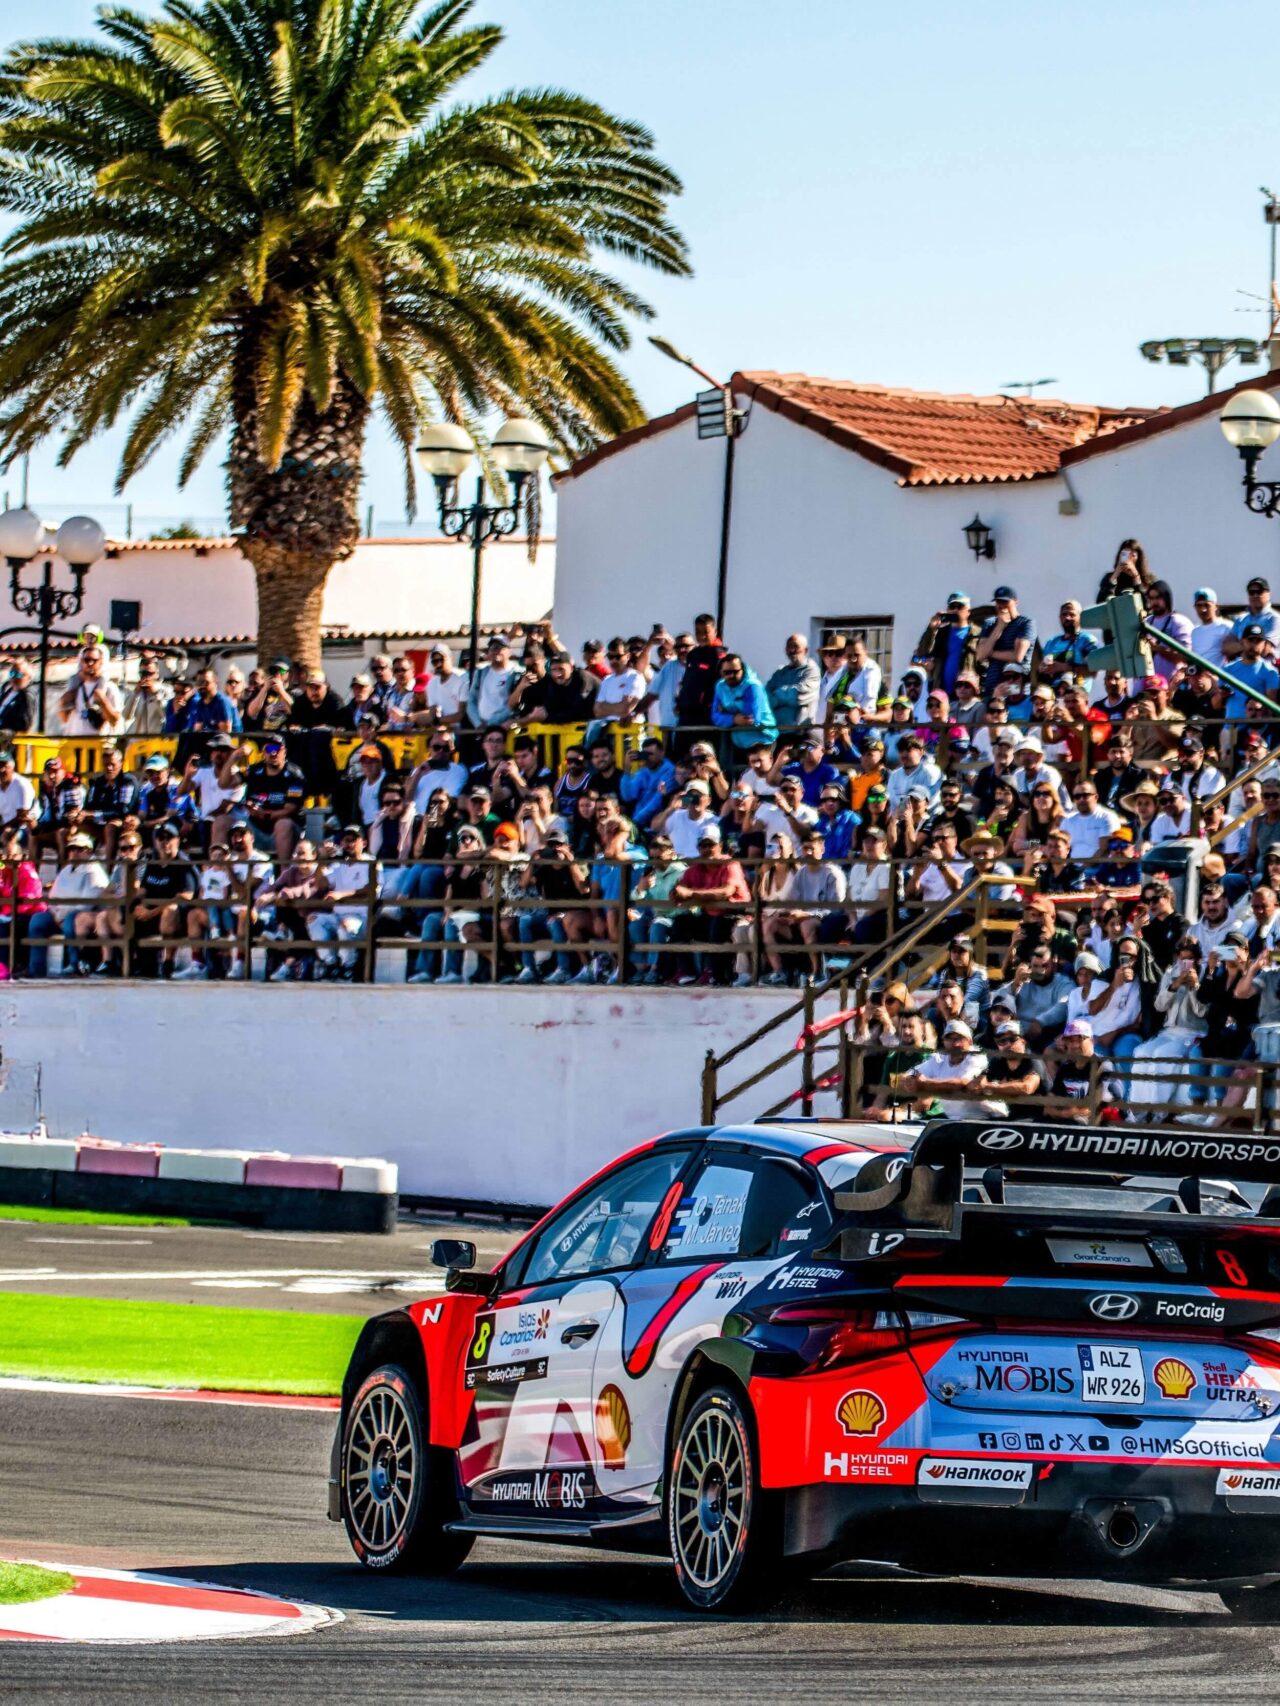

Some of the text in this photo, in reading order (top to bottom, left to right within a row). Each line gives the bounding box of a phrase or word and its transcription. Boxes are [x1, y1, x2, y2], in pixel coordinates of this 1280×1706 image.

[1029, 1132, 1149, 1155] HYUNDAI
[711, 1194, 747, 1215] Tänak
[650, 1181, 684, 1250] 8
[684, 1226, 698, 1245] M.
[797, 1267, 844, 1280] HYUNDAI
[1216, 1250, 1249, 1287] 8
[786, 1278, 820, 1289] STEEL
[518, 1311, 537, 1329] Islas
[1156, 1301, 1226, 1322] ForCraig
[473, 1322, 491, 1360] 8
[500, 1328, 536, 1347] Canarias
[958, 1351, 1029, 1363] HYUNDAI
[1099, 1350, 1132, 1369] ALZ
[1202, 1361, 1227, 1372] Shell
[487, 1365, 526, 1383] SafetyCulture
[975, 1364, 1075, 1394] MOBIS
[1204, 1373, 1260, 1389] HELIX
[1087, 1377, 1141, 1397] WR 926
[1206, 1388, 1258, 1403] ULTRA
[1121, 1436, 1265, 1458] @HMSGOfficial
[851, 1454, 909, 1465] HYUNDAI
[851, 1465, 893, 1477] STEEL
[492, 1471, 586, 1509] HYUNDAI MOBIS
